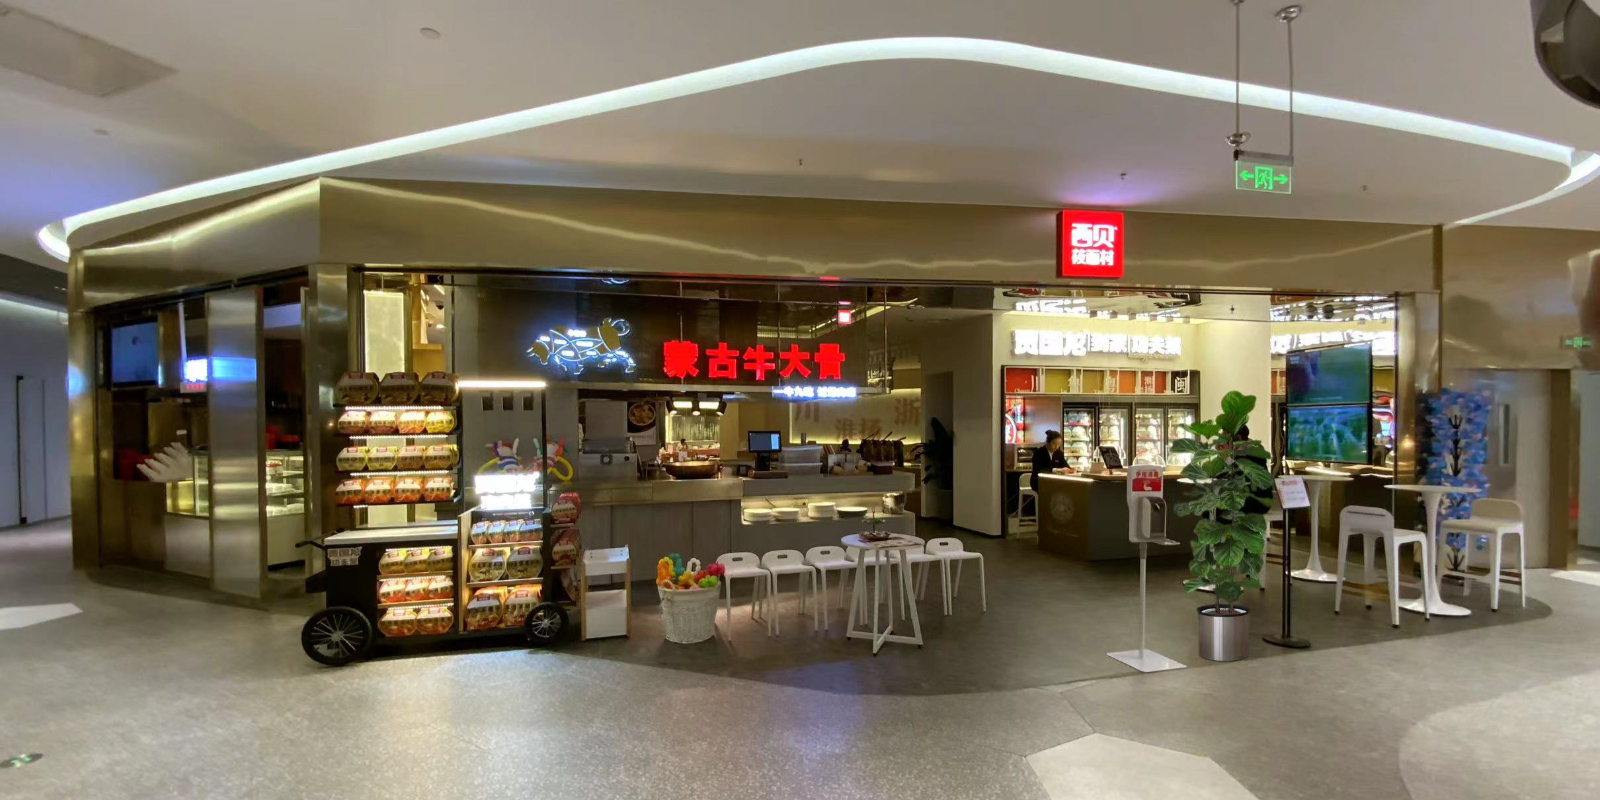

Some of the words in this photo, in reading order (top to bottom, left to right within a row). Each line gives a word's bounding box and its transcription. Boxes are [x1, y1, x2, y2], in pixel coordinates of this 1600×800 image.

[1071, 223, 1115, 248] 西贝
[663, 340, 845, 380] 蒙古牛大骨
